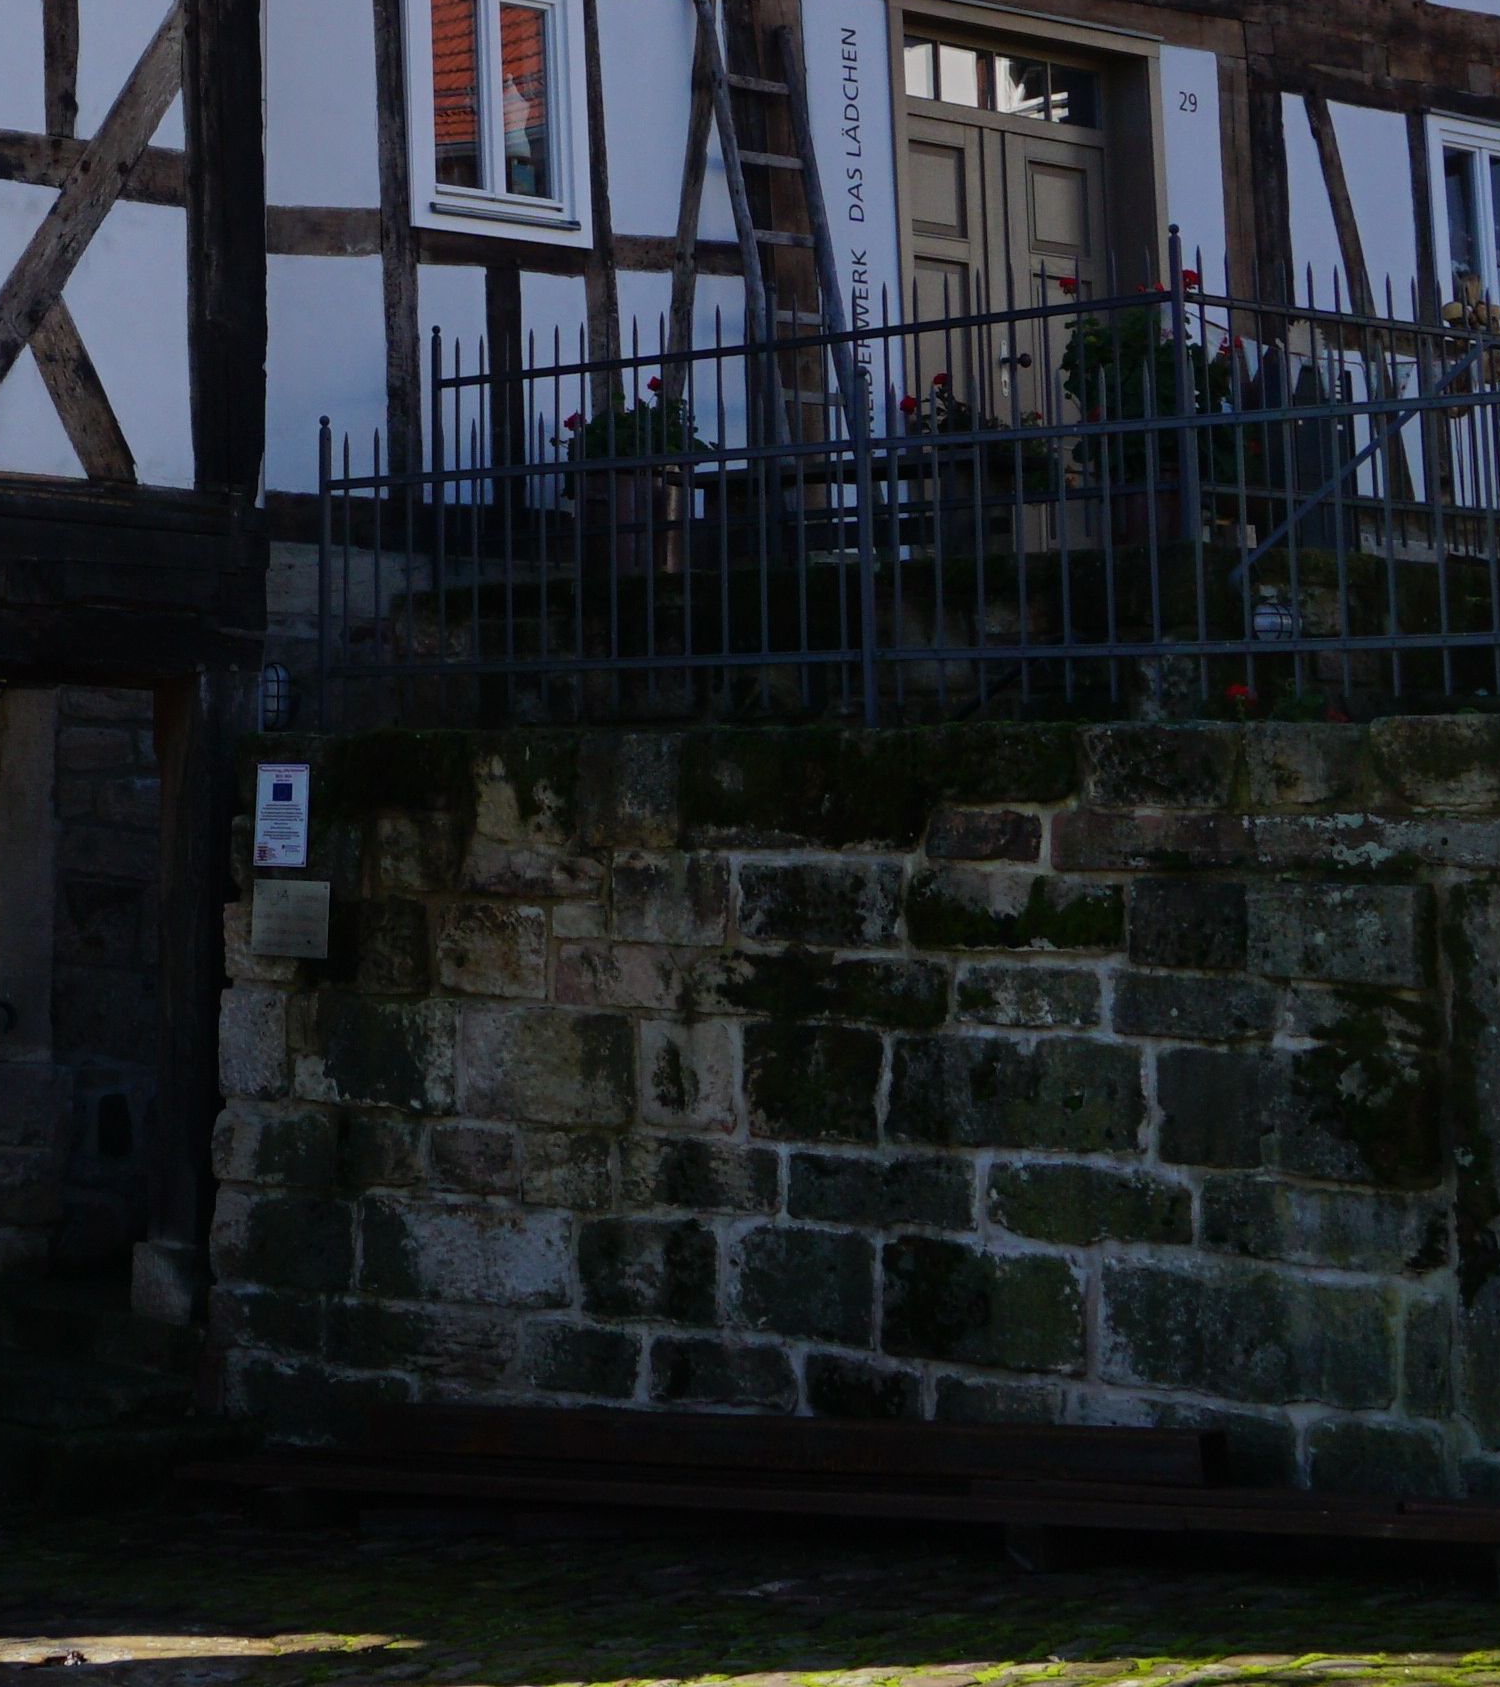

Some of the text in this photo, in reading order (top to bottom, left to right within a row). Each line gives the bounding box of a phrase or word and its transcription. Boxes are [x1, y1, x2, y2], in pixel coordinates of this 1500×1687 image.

[840, 27, 862, 158] LÄDCHEN
[1179, 91, 1198, 113] 29
[846, 167, 865, 223] DAS
